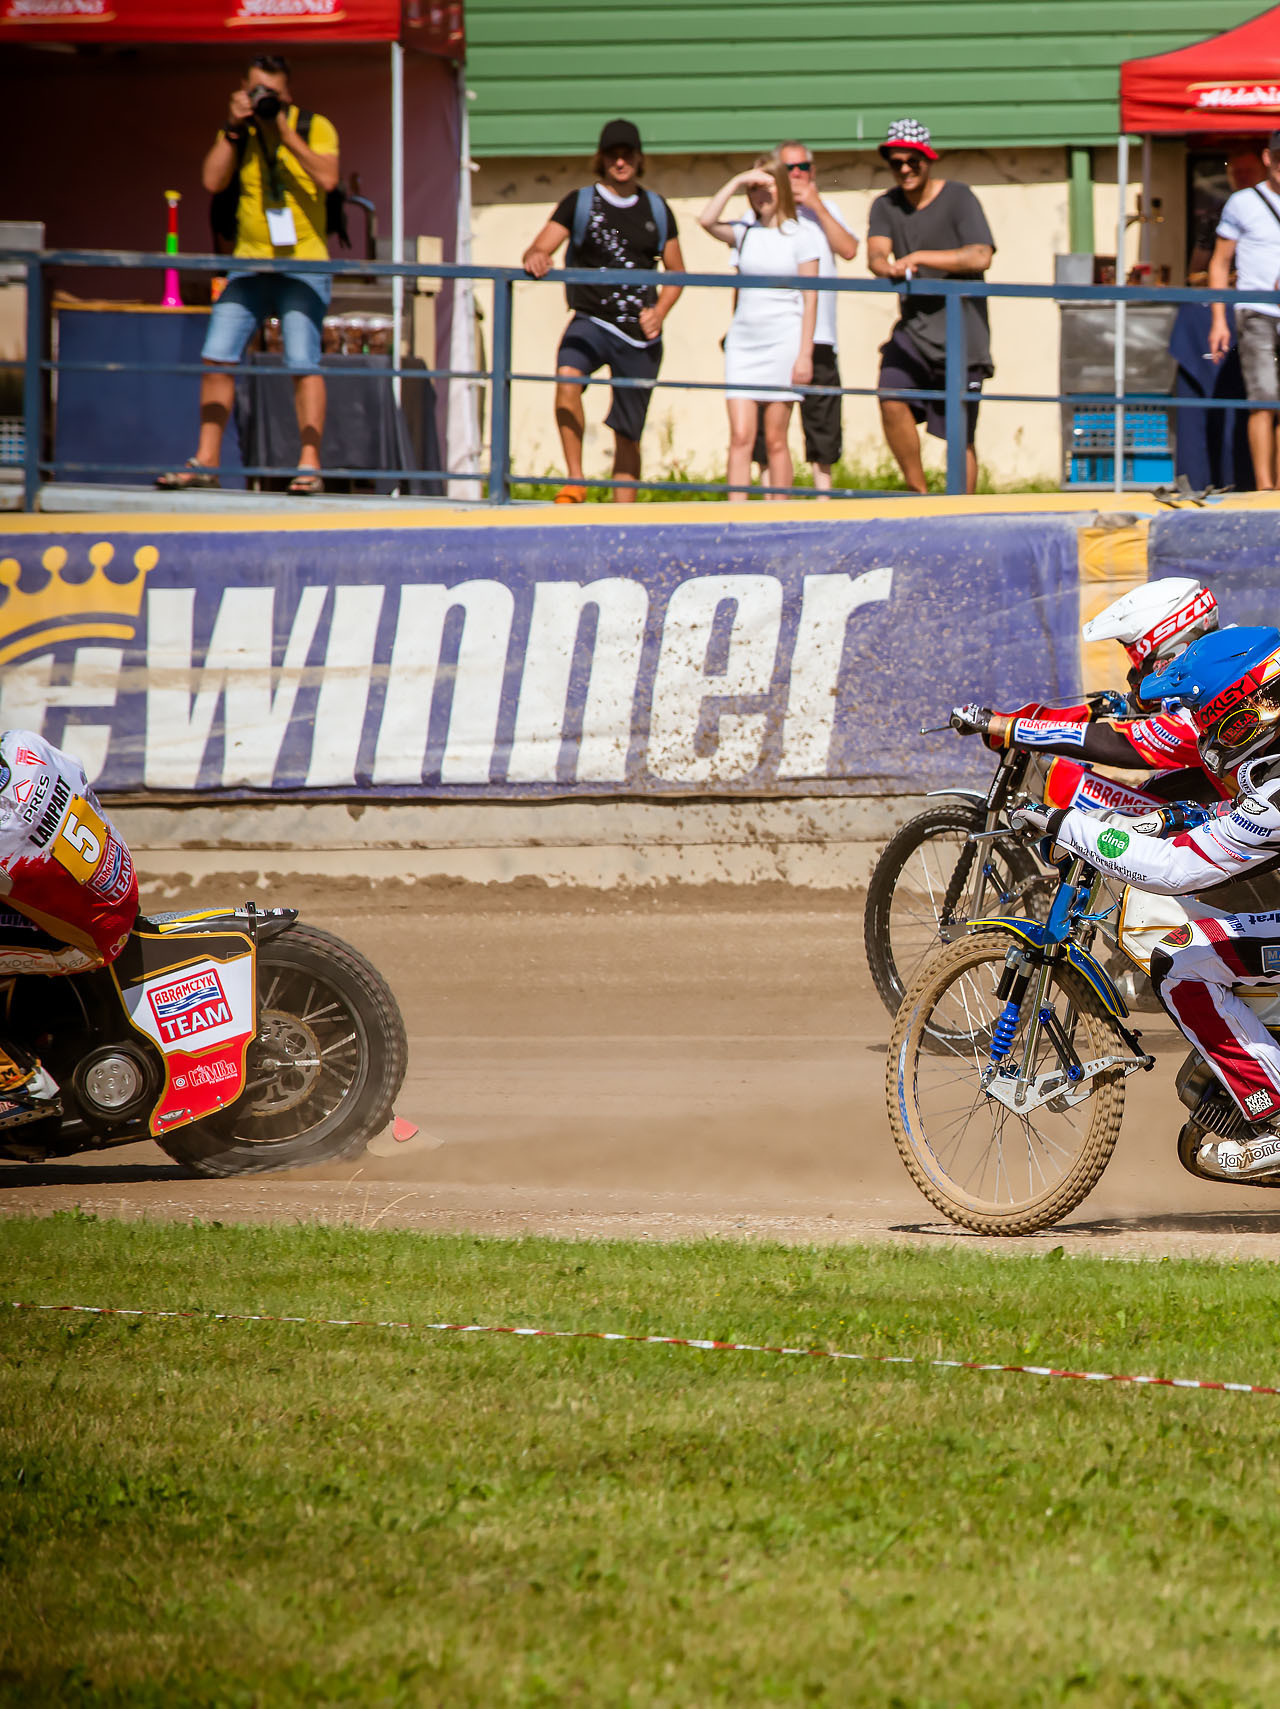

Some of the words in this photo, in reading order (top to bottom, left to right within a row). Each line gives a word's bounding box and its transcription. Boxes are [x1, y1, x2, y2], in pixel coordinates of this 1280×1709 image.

[1200, 680, 1245, 724] OAKLEY
[23, 775, 50, 823] PRES
[28, 775, 71, 849] LAMPART
[61, 812, 100, 863] 5
[1101, 831, 1126, 850] dina
[154, 974, 216, 1005] ABRAMCZYK
[161, 1002, 231, 1040] TEAM
